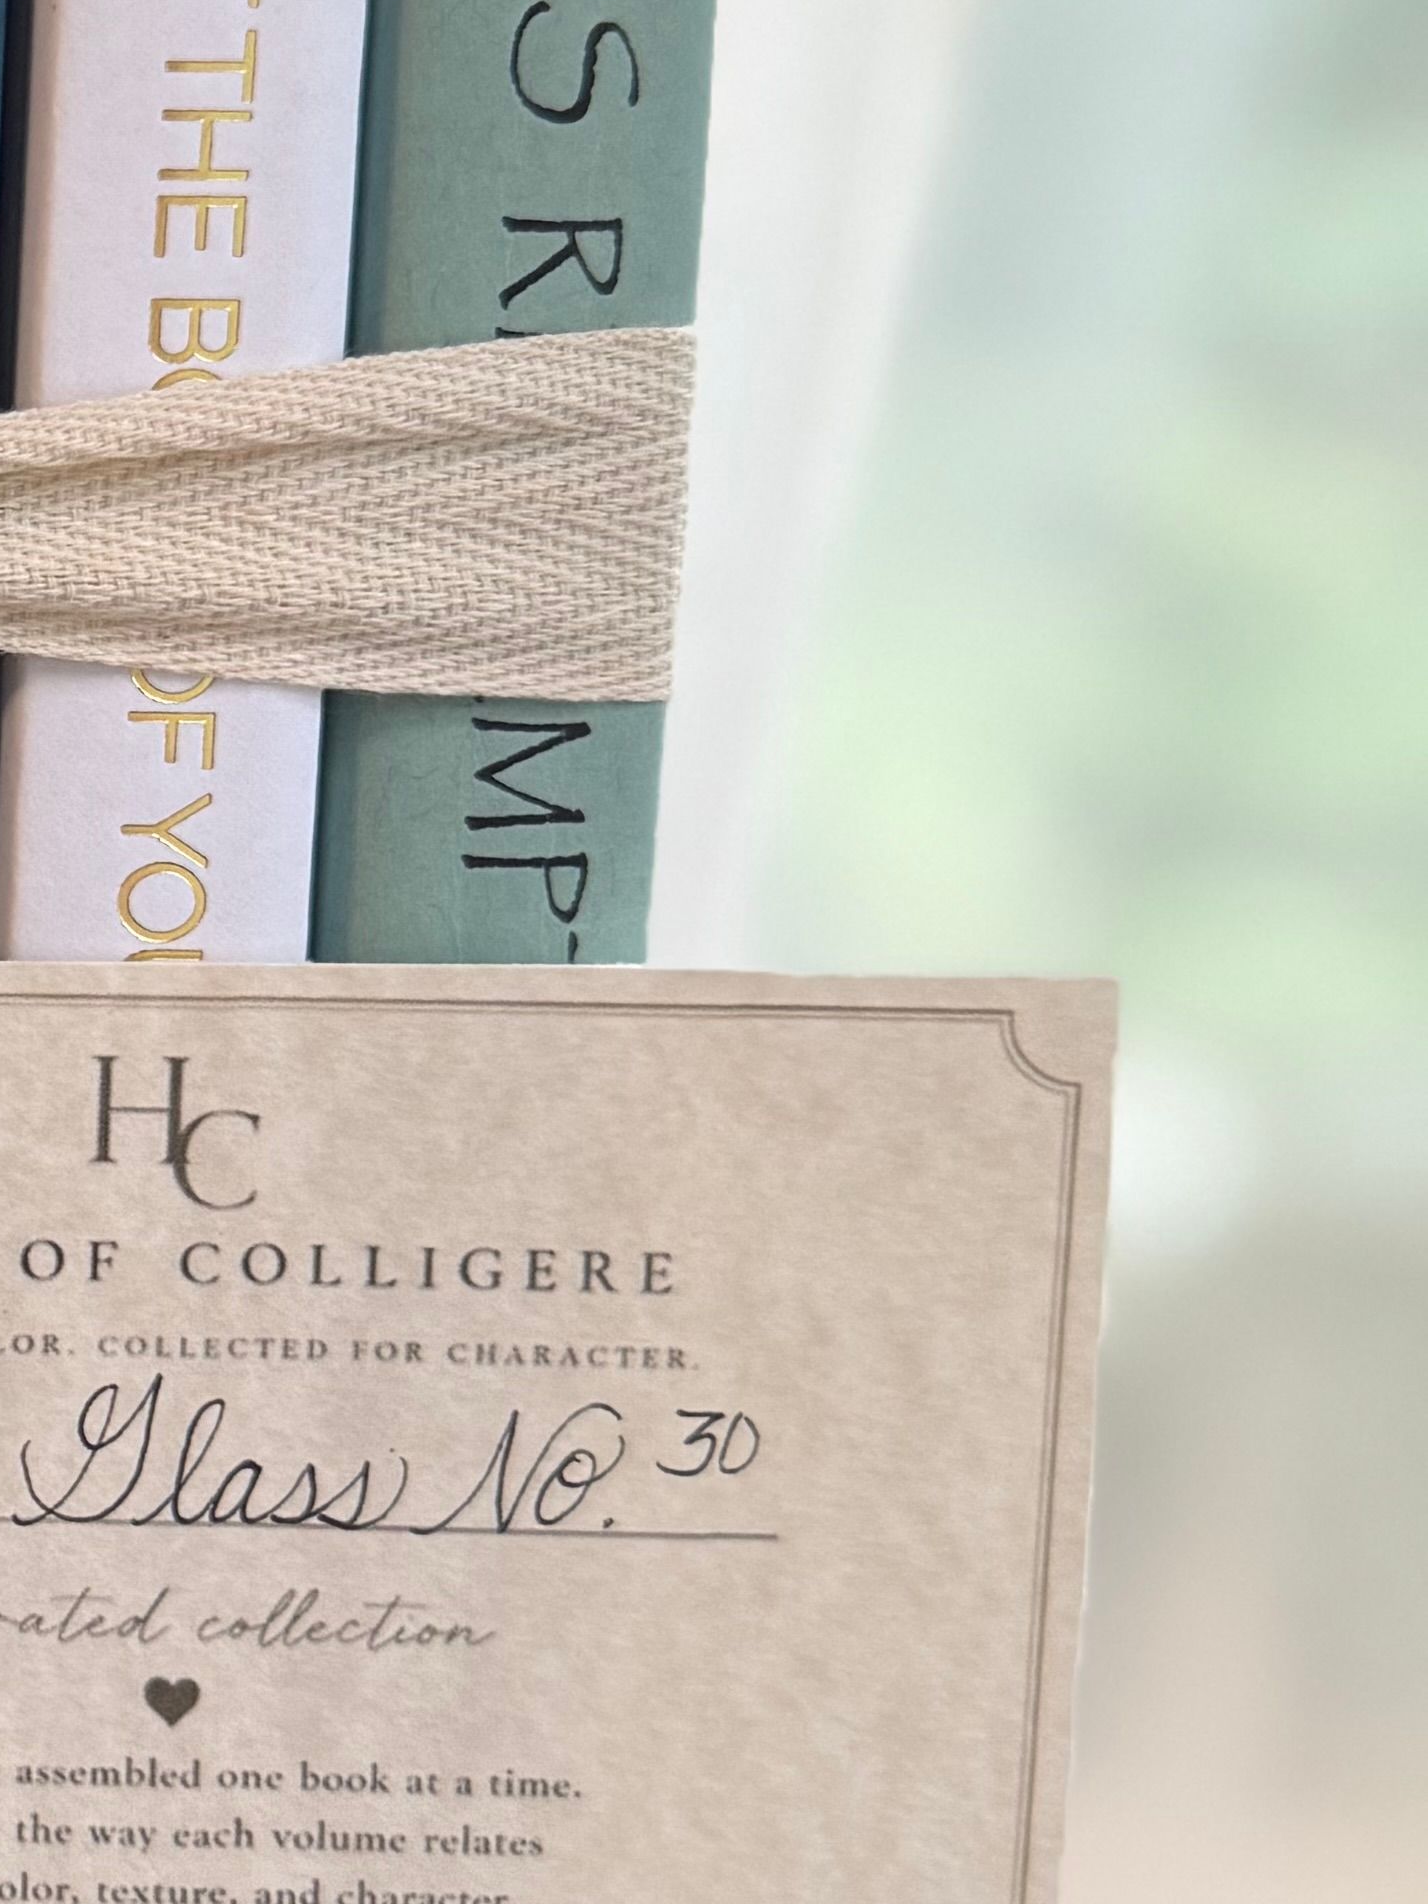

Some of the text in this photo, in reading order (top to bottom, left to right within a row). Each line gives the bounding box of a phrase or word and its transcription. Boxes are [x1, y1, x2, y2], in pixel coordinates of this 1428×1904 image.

[152, 29, 259, 260] THE
[19, 1238, 120, 1283] OF
[178, 1241, 675, 1297] COLLIGERE
[97, 1334, 329, 1361] COLLECTED
[351, 1339, 425, 1364] FOR
[446, 1342, 700, 1371] CHARACTER.
[12, 1372, 408, 1531] Glass
[655, 1408, 761, 1477] 30
[196, 1587, 500, 1651] collection
[15, 1755, 202, 1791] assembled
[215, 1769, 284, 1791] one
[299, 1759, 391, 1795] book
[405, 1773, 441, 1797] at
[455, 1776, 474, 1798] a
[489, 1768, 582, 1800] time.
[16, 1811, 73, 1847] the
[88, 1825, 158, 1855] way
[172, 1816, 255, 1850] each
[271, 1819, 407, 1855] volume
[424, 1823, 544, 1857] relates
